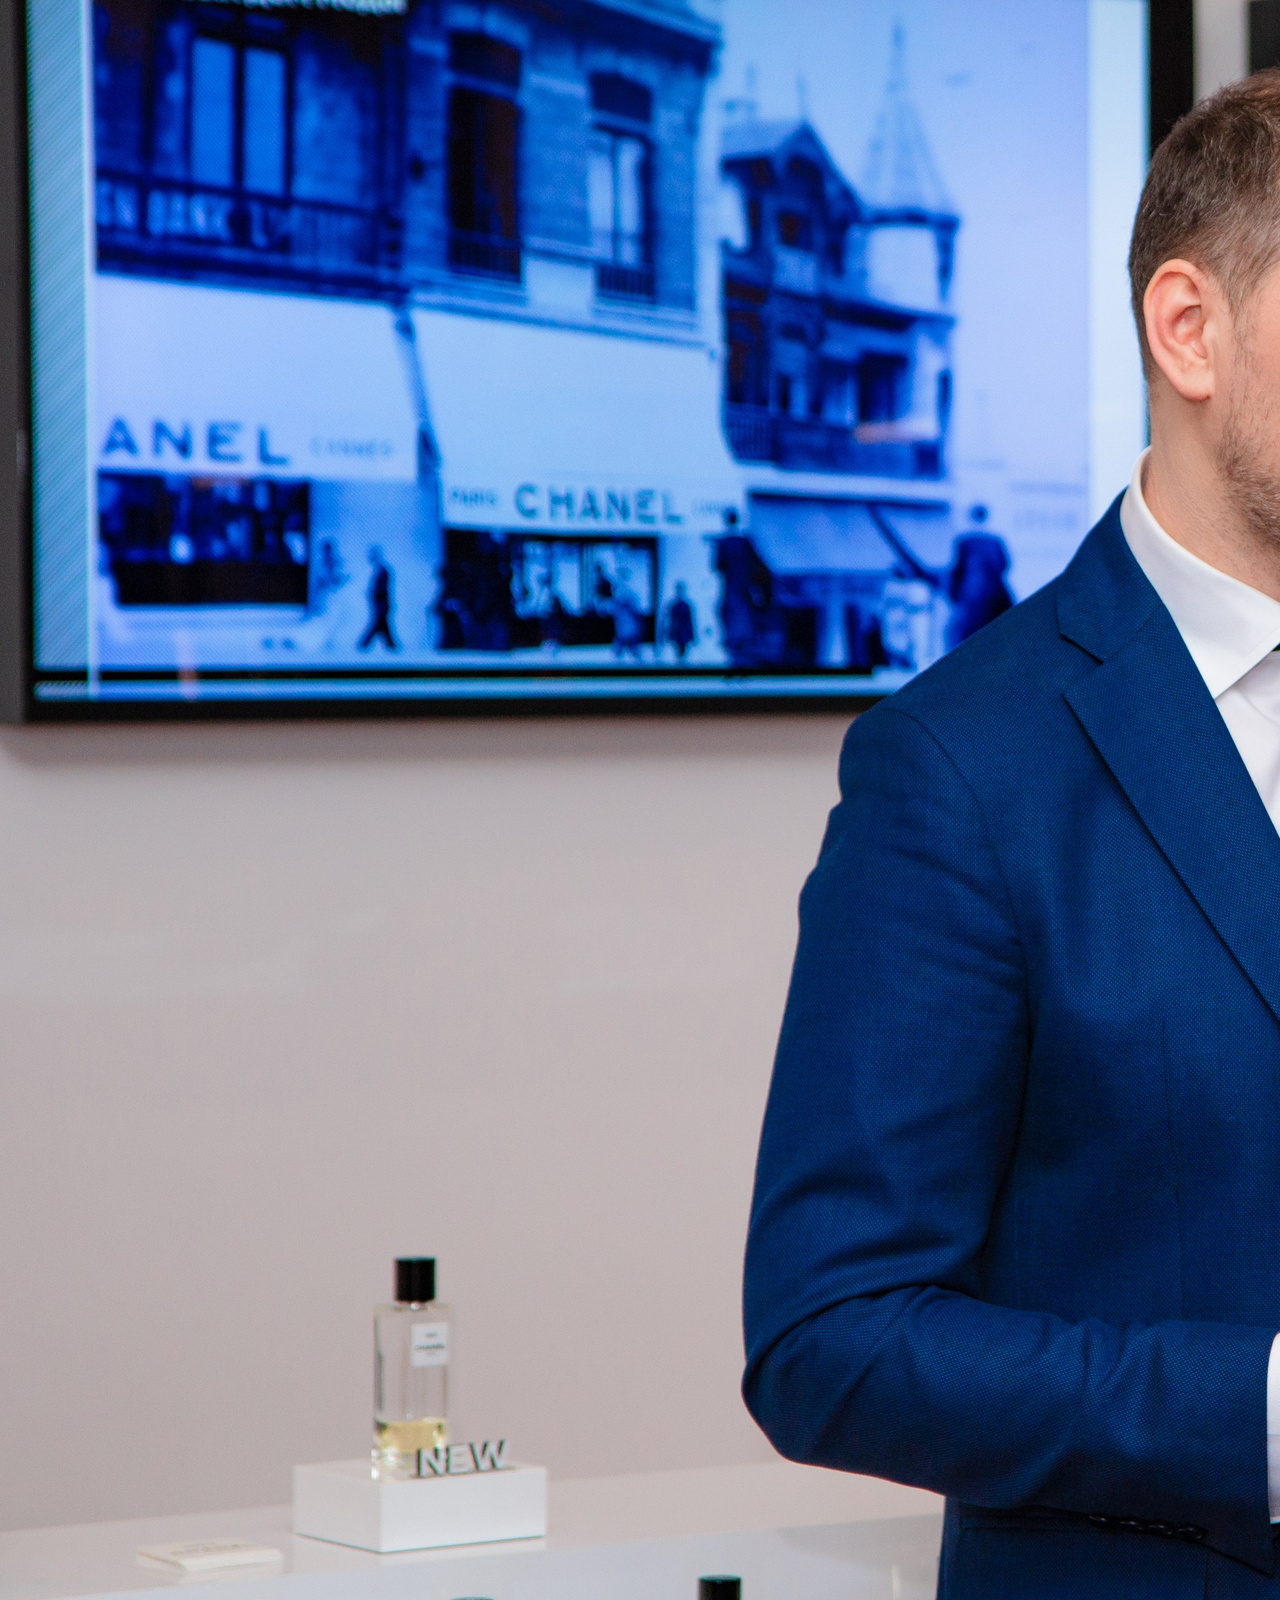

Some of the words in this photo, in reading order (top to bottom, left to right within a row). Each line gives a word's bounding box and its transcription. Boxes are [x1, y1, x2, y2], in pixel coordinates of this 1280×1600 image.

[101, 416, 291, 466] ANEL
[514, 483, 685, 525] CHANEL
[415, 1439, 509, 1478] NEW
